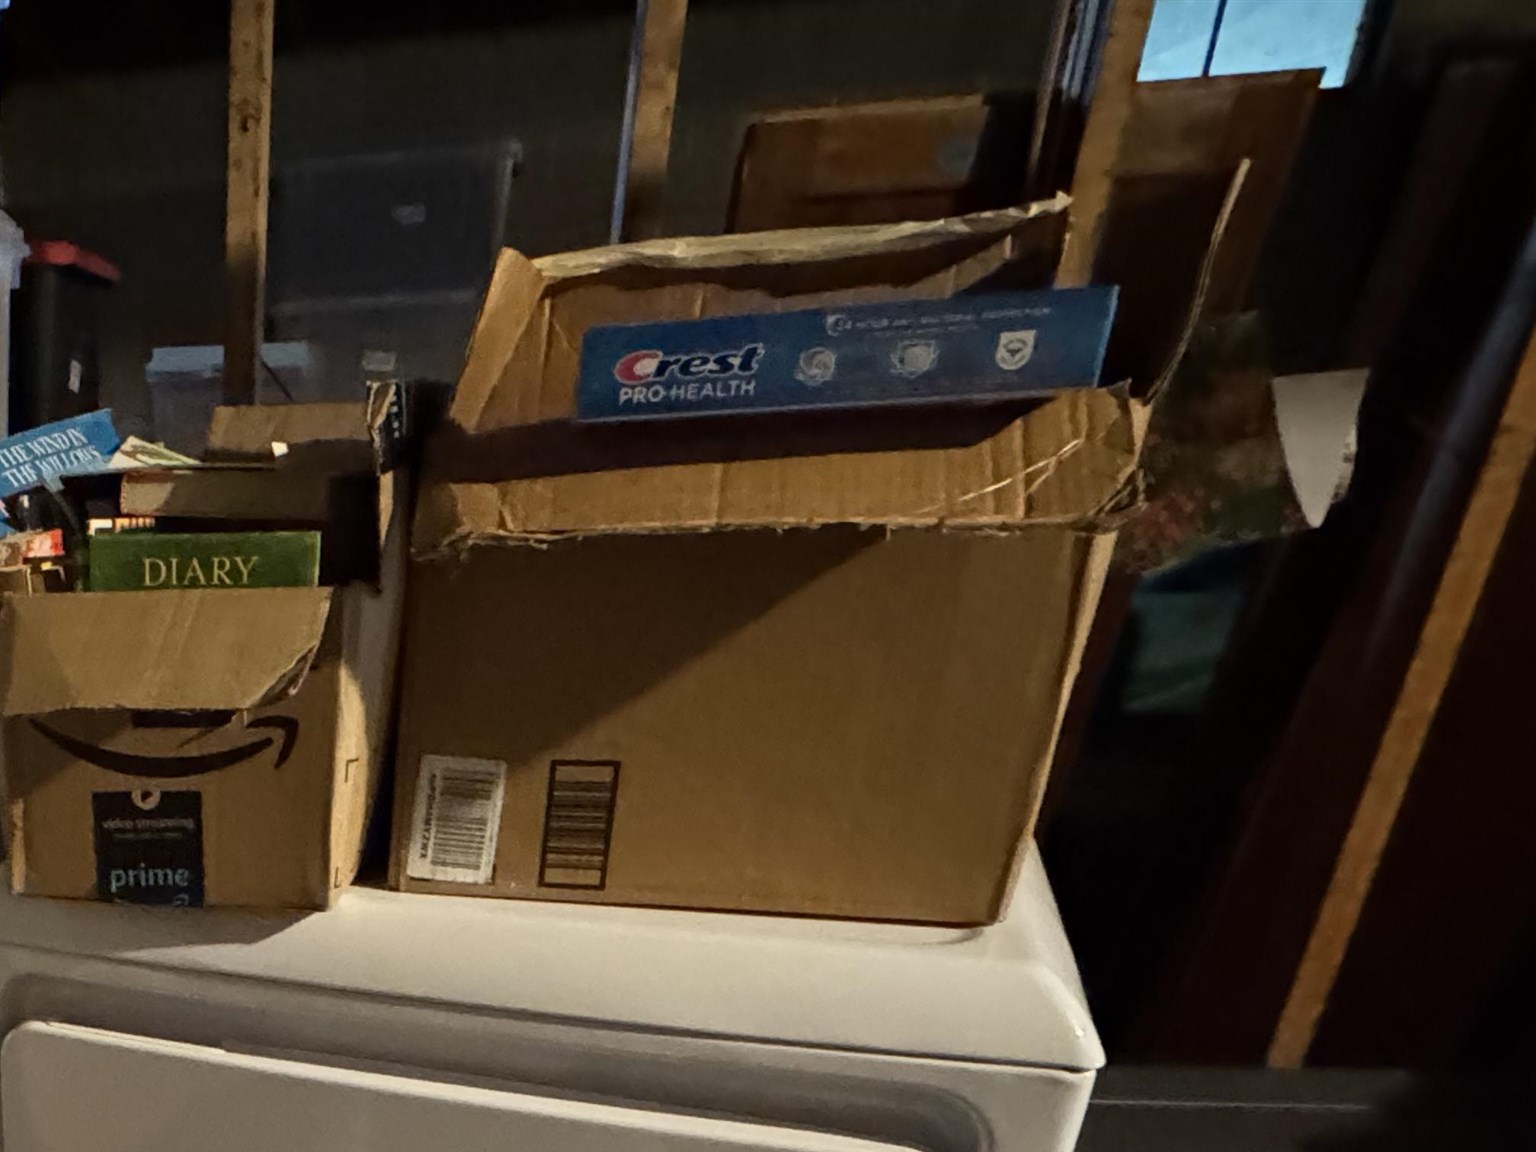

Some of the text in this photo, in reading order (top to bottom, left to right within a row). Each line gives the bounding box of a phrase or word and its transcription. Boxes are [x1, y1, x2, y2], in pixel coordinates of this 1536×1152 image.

[614, 342, 764, 385] Crest
[27, 430, 73, 459] WIND
[69, 427, 89, 448] IN
[1, 445, 103, 488] THE WILLOWS
[142, 555, 260, 587] DIARY
[110, 862, 189, 894] prime
